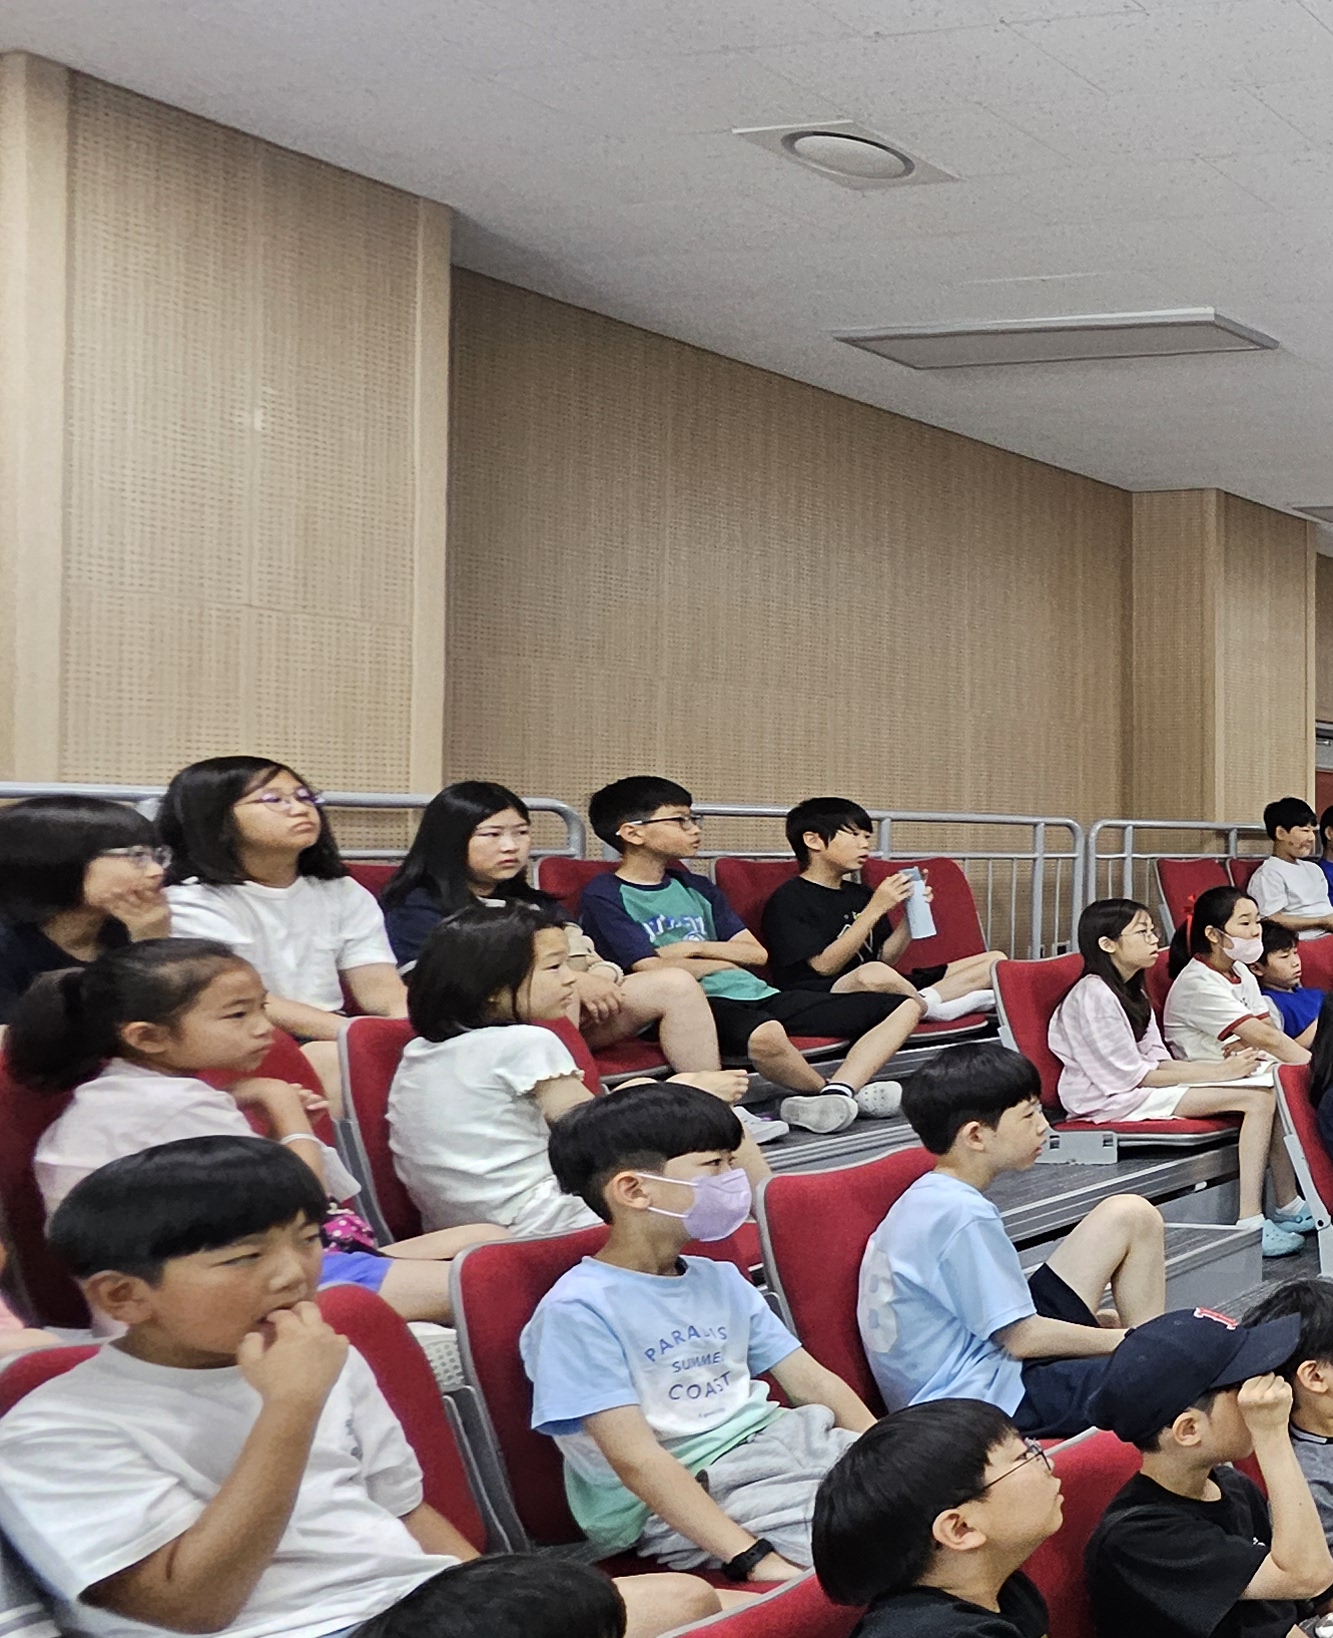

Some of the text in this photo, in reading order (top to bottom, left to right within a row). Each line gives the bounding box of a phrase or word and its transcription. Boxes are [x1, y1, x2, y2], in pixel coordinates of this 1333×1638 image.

[644, 1325, 728, 1362] PARAIS
[671, 1351, 721, 1374] SUMME
[668, 1370, 731, 1400] COAST
